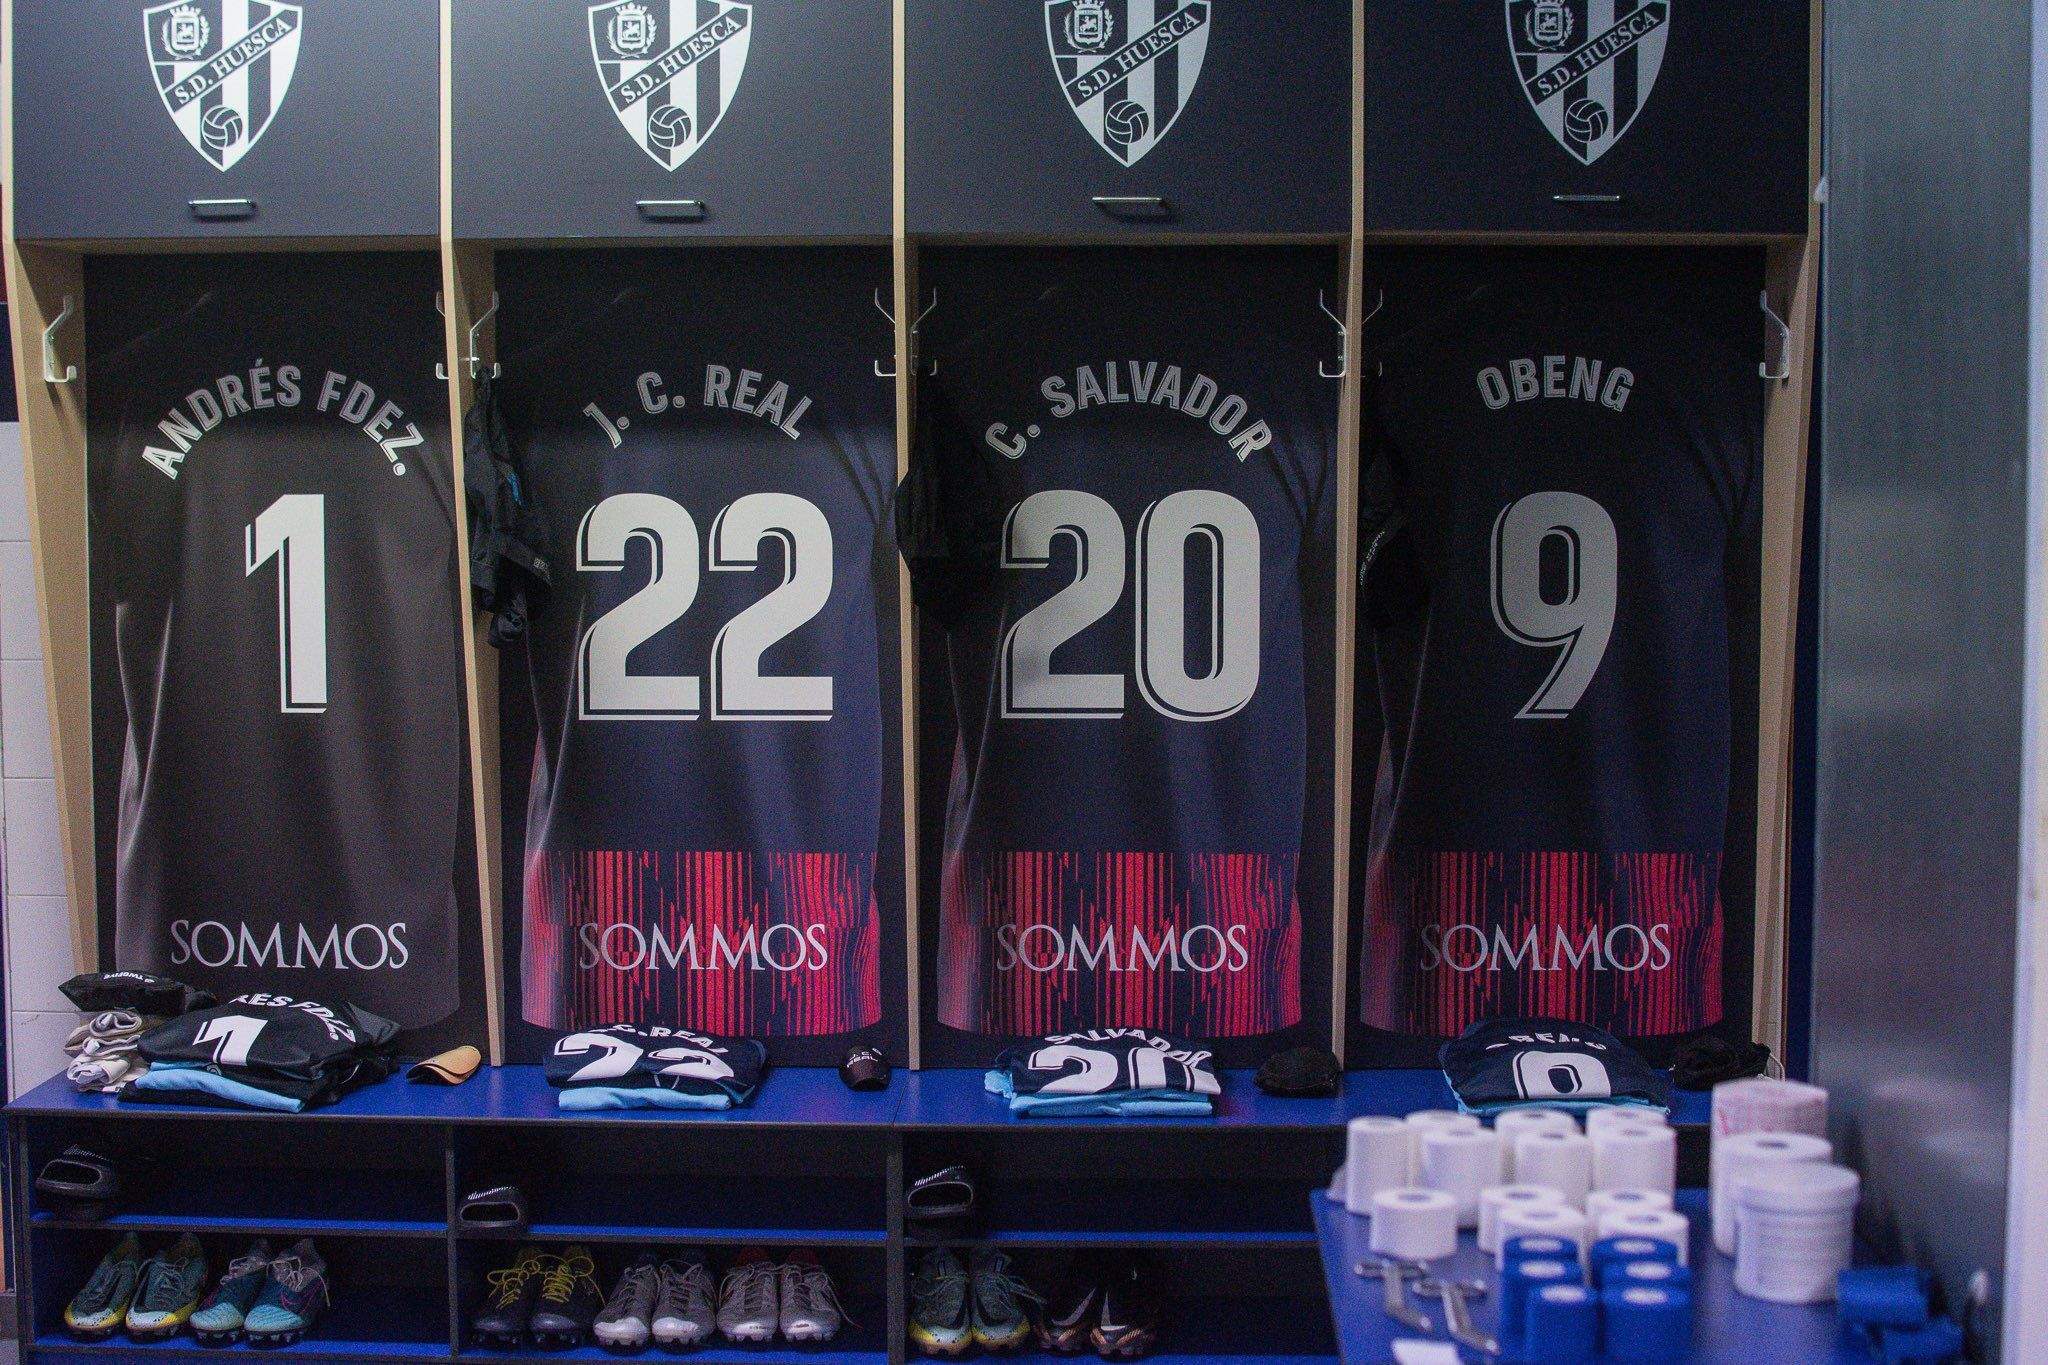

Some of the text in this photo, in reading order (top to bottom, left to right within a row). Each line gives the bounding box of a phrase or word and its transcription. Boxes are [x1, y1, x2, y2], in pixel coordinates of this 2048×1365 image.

[174, 17, 293, 104] S.D. HUESCA
[620, 16, 742, 103] S.D. HUESCA
[1077, 12, 1200, 97] S.D. HUESCA
[1537, 11, 1660, 96] S.D. HUESCA
[141, 357, 425, 480] ANDRÉS FDEZ.
[583, 364, 813, 449] J. C. REAL
[985, 361, 1272, 462] C. SALVADOR
[1476, 355, 1635, 413] OBENG
[245, 494, 328, 714] 1
[576, 492, 833, 721] 22
[1000, 489, 1261, 722] 20
[1490, 491, 1618, 719] 9
[170, 919, 410, 970] SOMMOS
[579, 922, 829, 972] SOMMOS
[996, 923, 1249, 973] SOMMOS
[1419, 923, 1672, 972] SOMMOS
